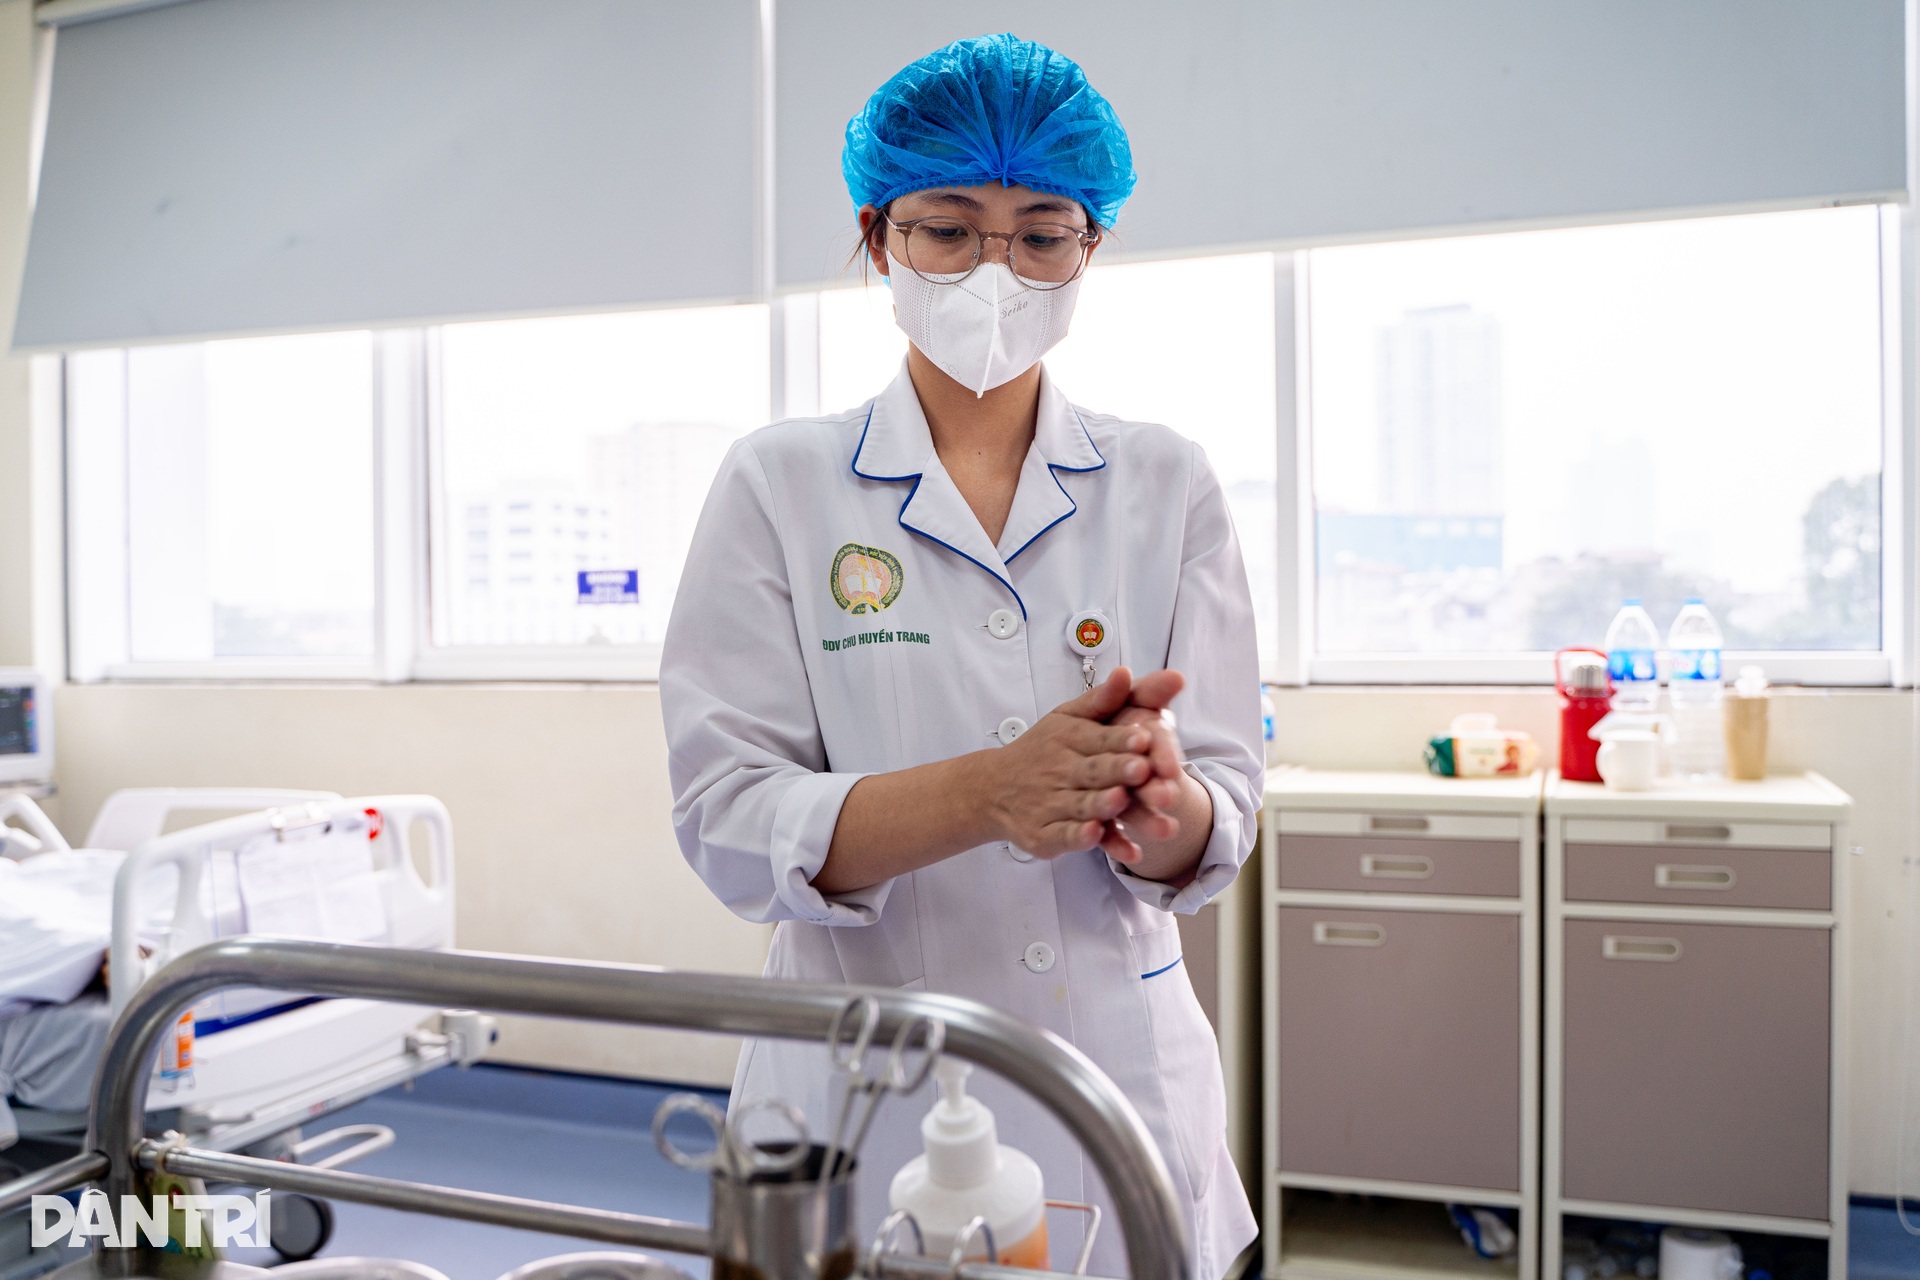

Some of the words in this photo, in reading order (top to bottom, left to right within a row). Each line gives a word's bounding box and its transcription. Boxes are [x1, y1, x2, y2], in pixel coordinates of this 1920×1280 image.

[822, 639, 840, 651] ĐDV
[842, 635, 856, 650] CHU
[896, 631, 930, 644] TRANG
